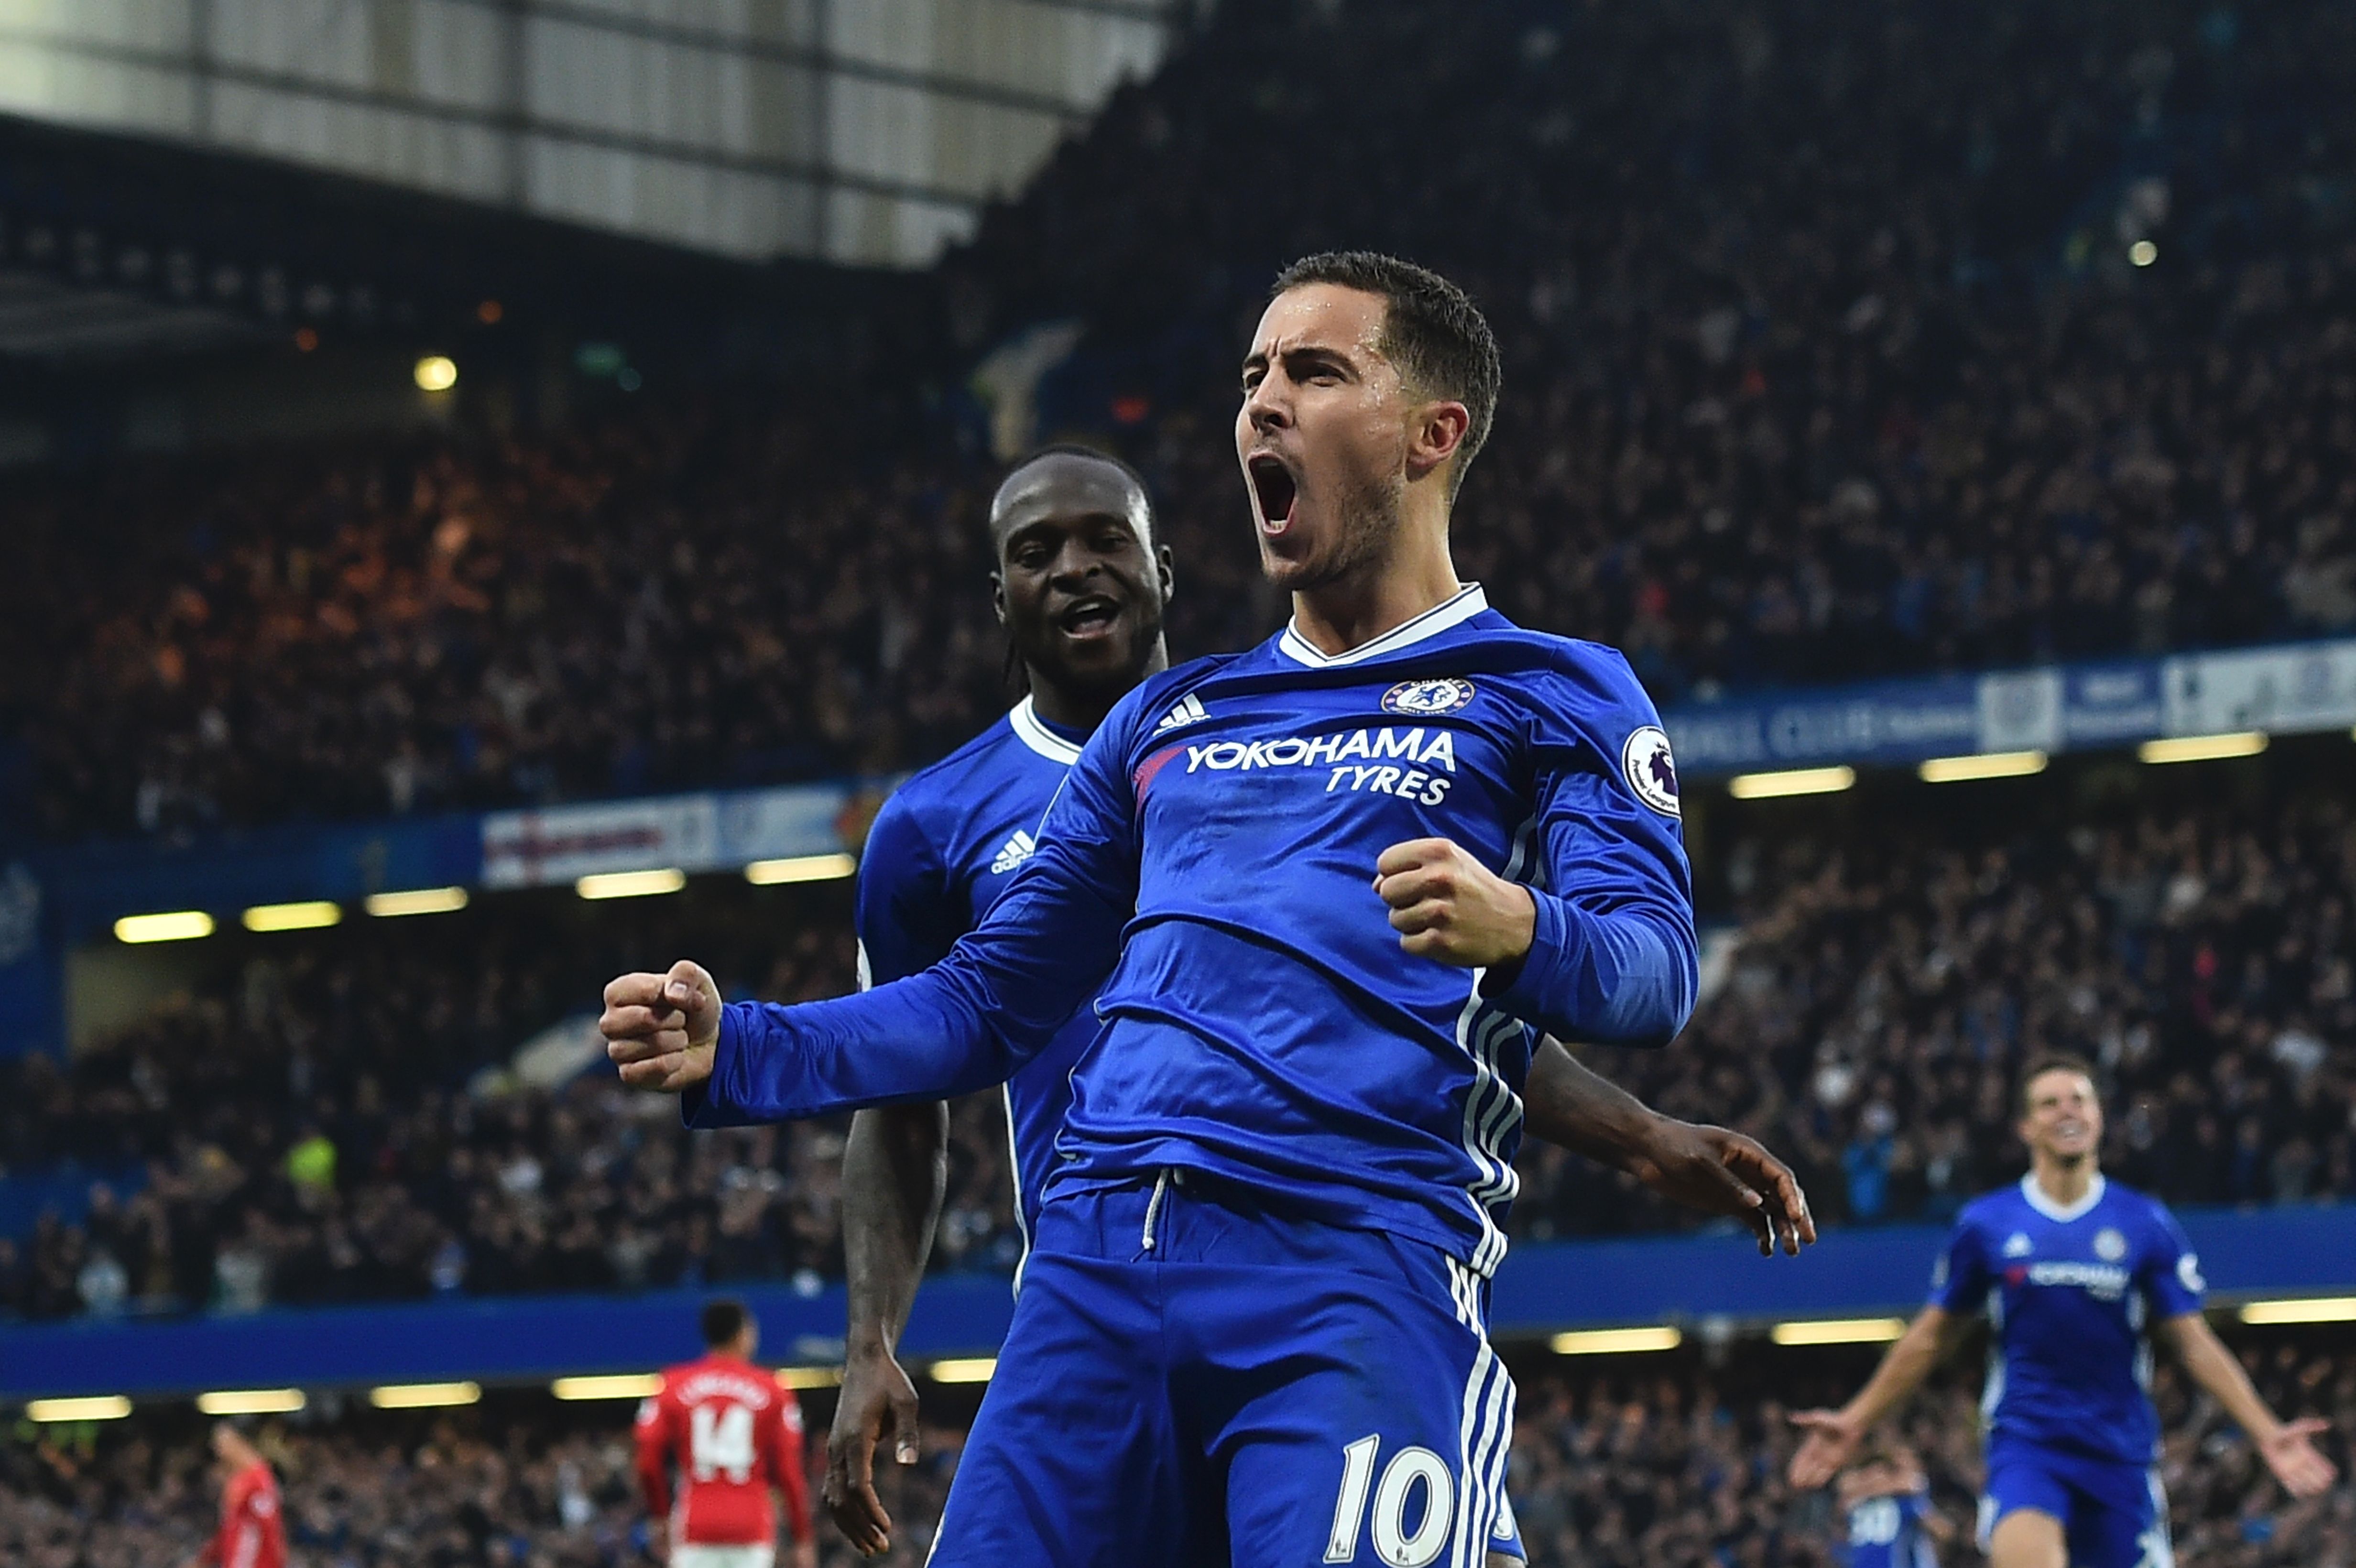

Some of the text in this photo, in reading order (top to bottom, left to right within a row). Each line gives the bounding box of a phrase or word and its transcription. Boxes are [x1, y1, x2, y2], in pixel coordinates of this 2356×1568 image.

[1187, 728, 1456, 773] YOKOHAMA
[1326, 765, 1451, 806] TYRES
[1632, 759, 1648, 790] Premier
[691, 1403, 756, 1485] 14
[1323, 1433, 1454, 1568] 10
